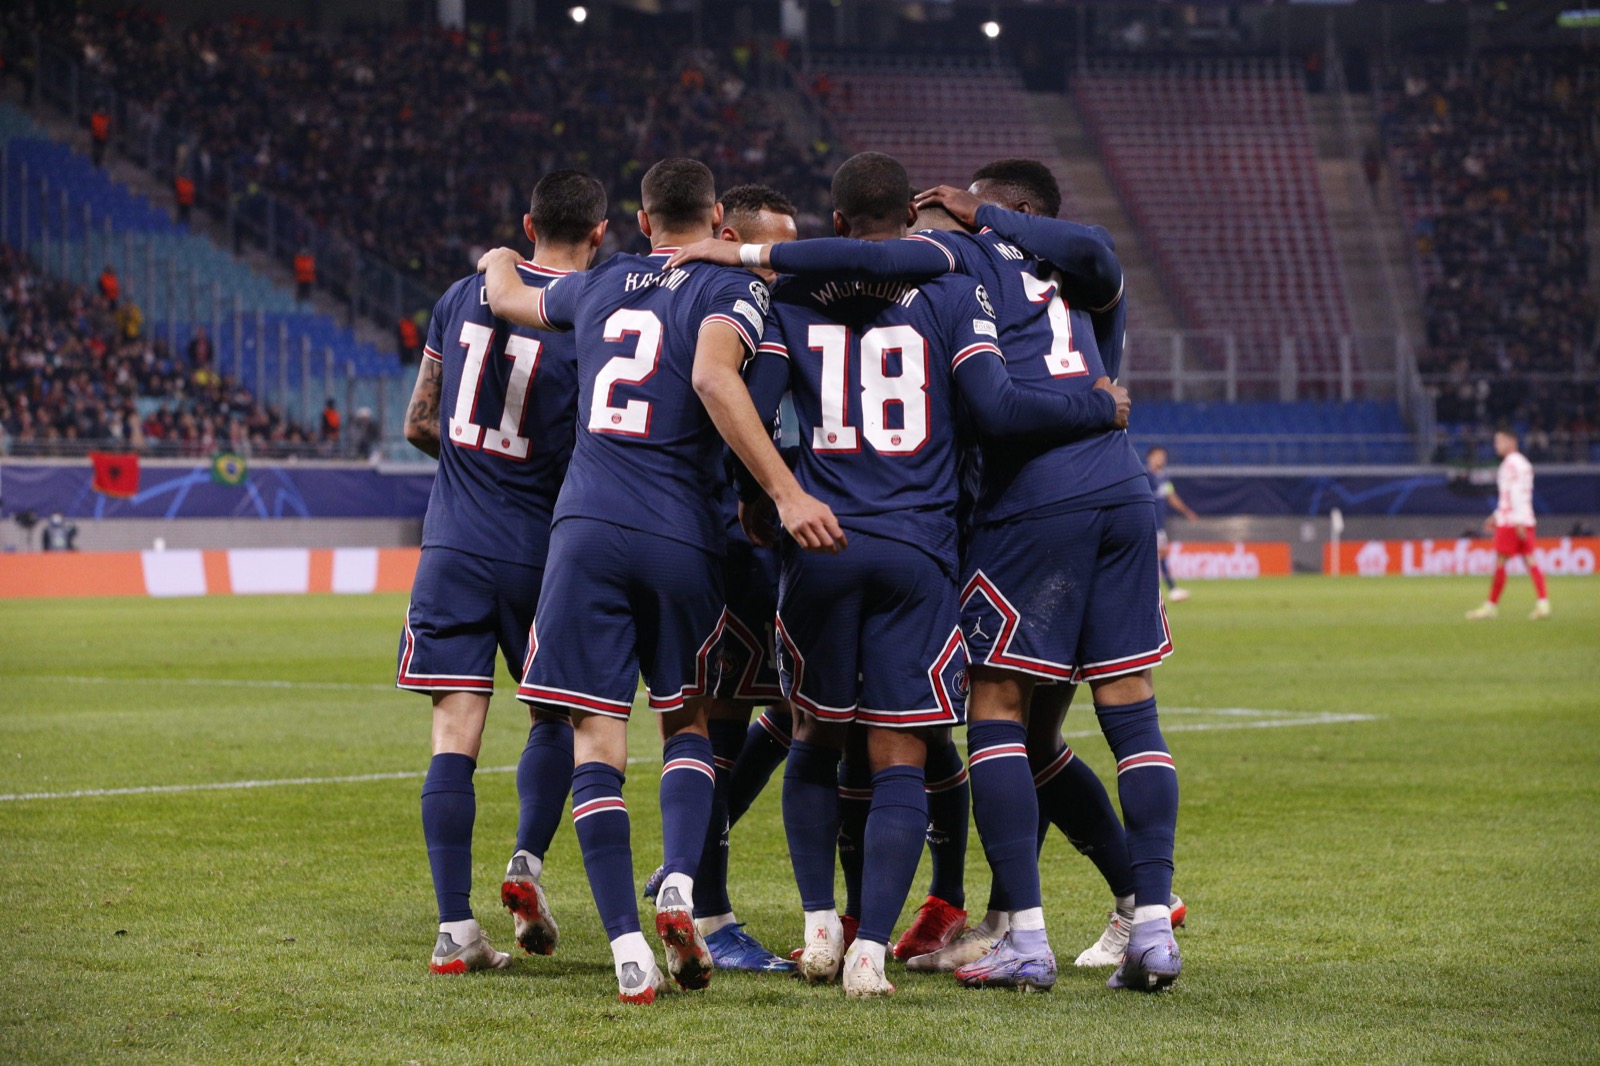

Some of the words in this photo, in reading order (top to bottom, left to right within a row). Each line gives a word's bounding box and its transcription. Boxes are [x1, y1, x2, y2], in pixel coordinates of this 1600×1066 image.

[588, 307, 664, 438] 2
[1020, 268, 1089, 380] 7
[449, 321, 544, 463] 11
[807, 324, 931, 456] 18
[1402, 537, 1596, 577] Liefedo
